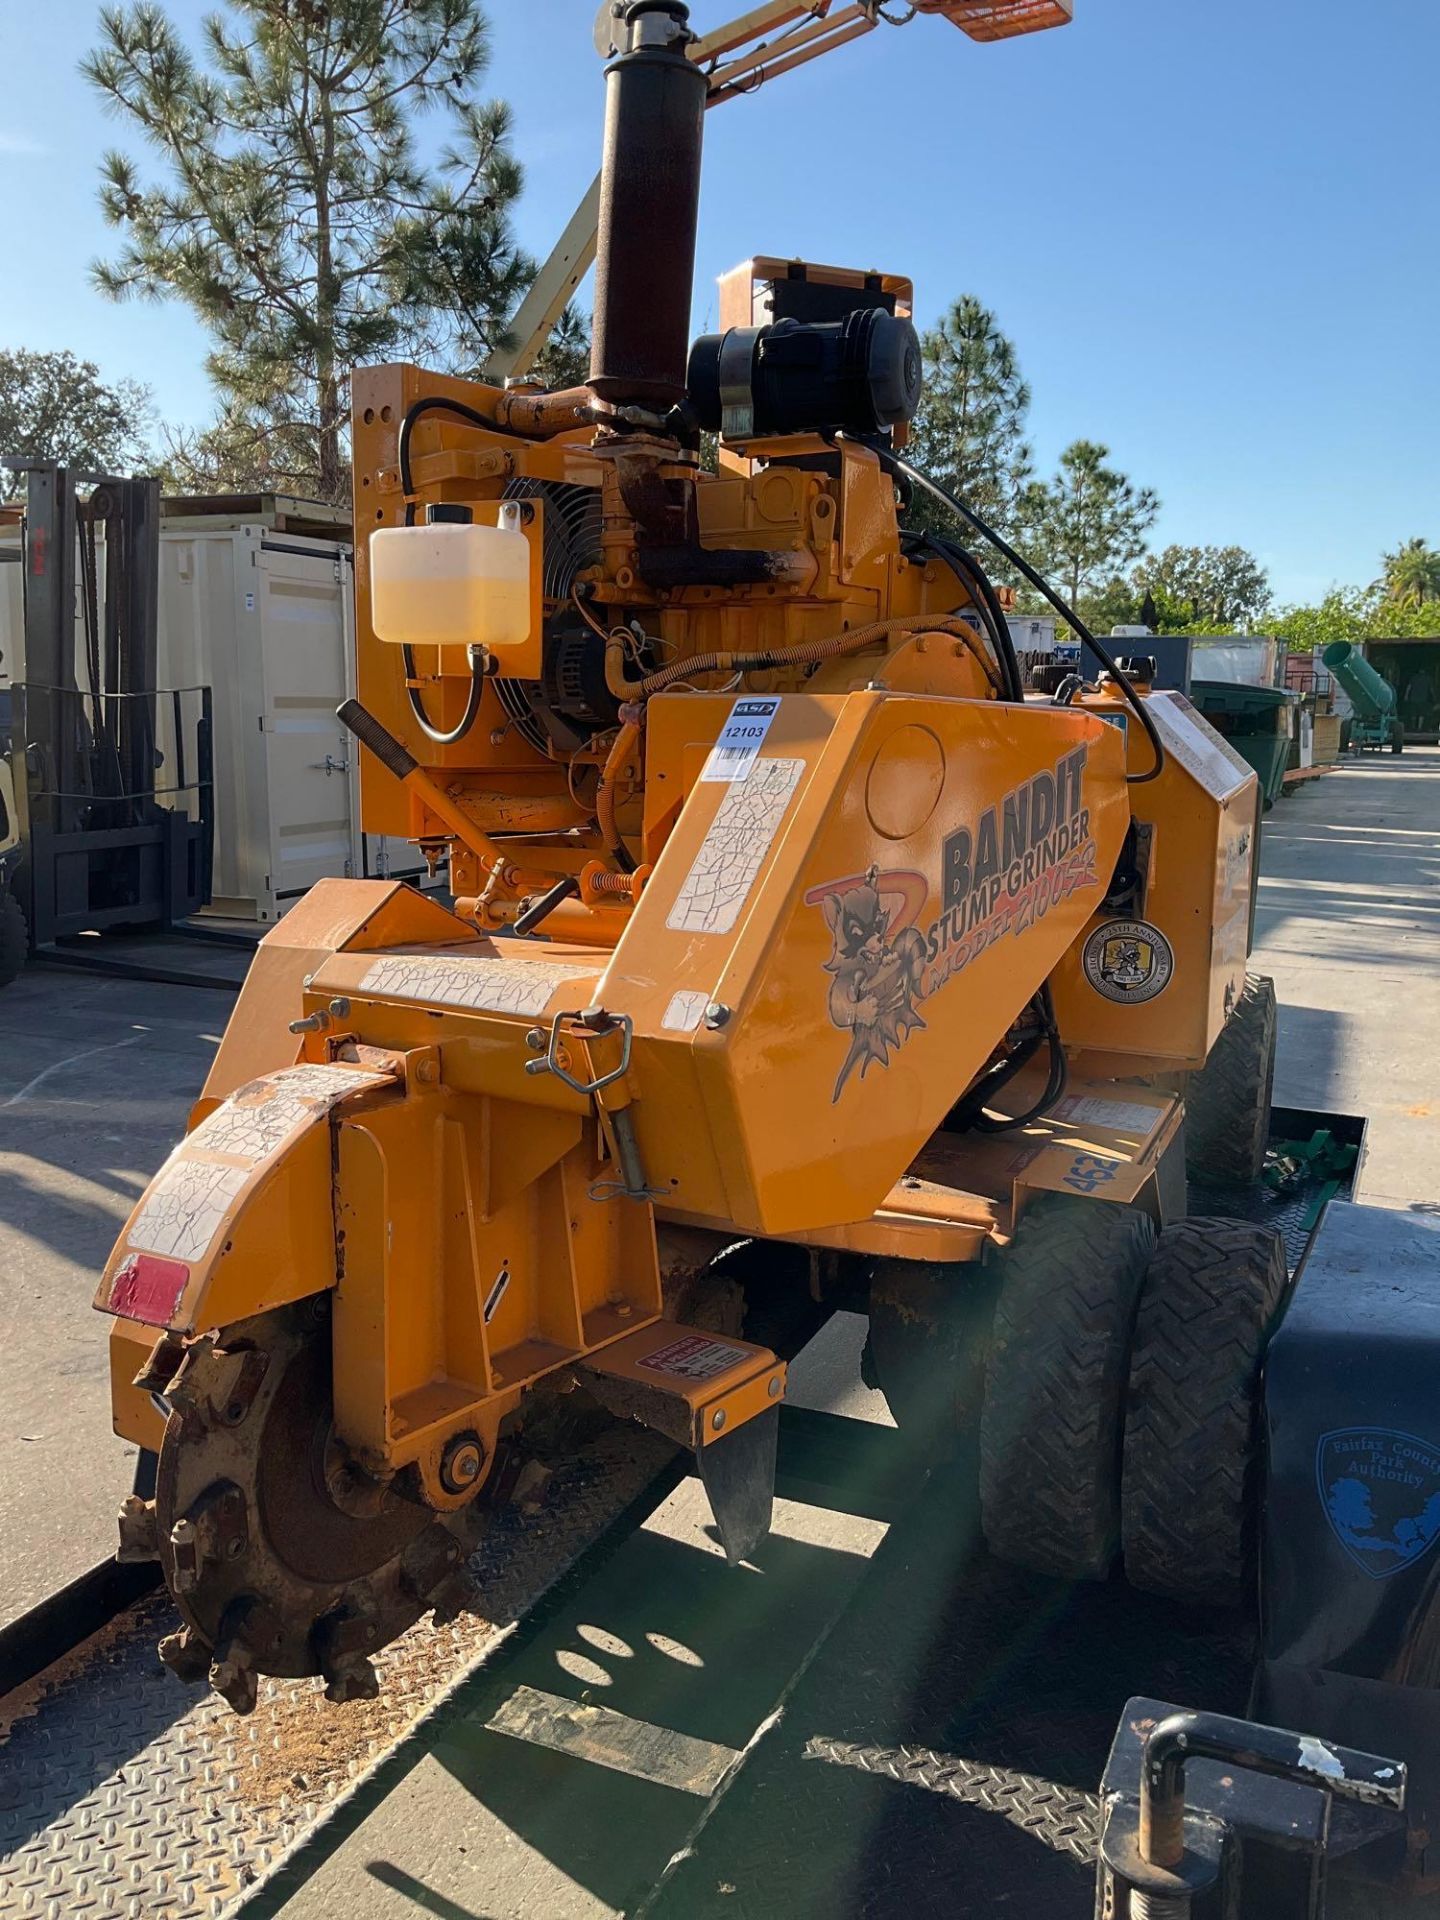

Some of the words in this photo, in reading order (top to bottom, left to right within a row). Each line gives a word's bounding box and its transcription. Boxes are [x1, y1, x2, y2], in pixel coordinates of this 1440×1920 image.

[725, 727, 764, 738] 12103
[943, 742, 1088, 910] BANDIT
[926, 875, 1003, 963] STUMP
[1006, 811, 1090, 897] GRINDER
[928, 908, 1012, 993] MODEL
[1132, 925, 1168, 977] ANNIVERSARY
[1333, 1436, 1384, 1453] Fairfax
[1371, 1451, 1405, 1469] Park
[1348, 1459, 1425, 1489] Authority
